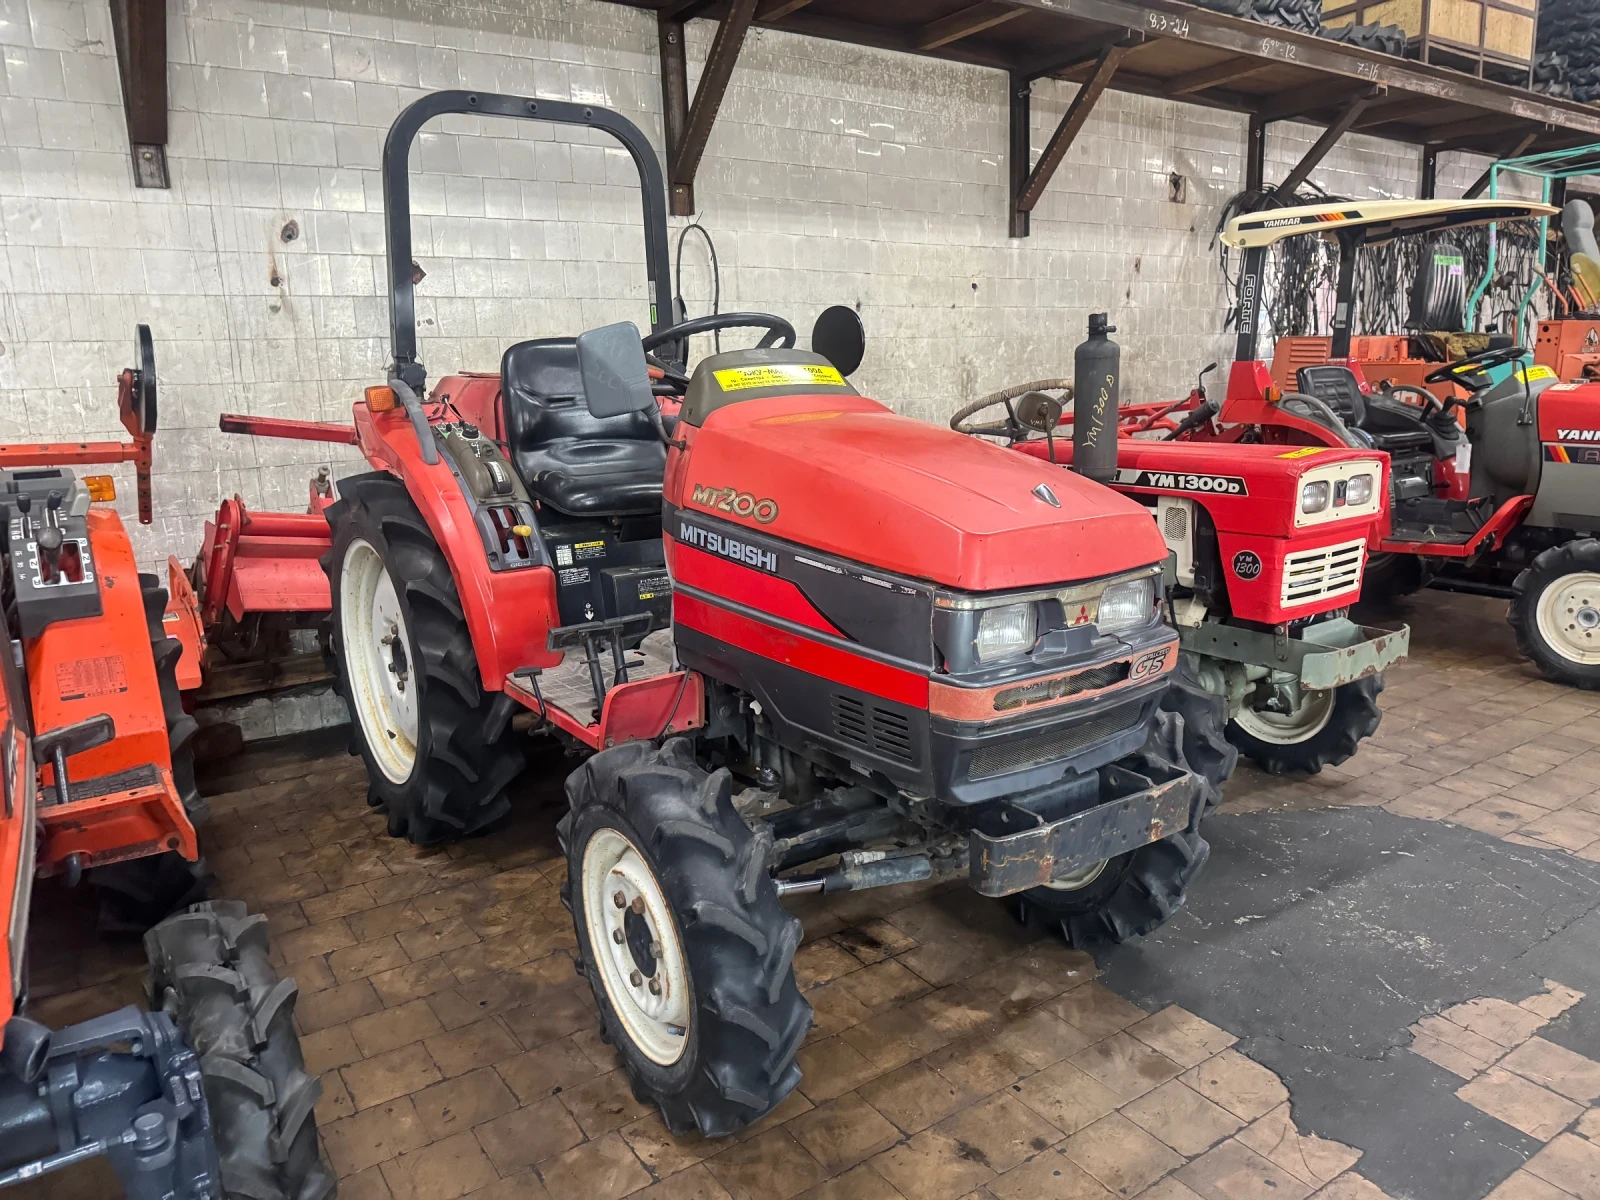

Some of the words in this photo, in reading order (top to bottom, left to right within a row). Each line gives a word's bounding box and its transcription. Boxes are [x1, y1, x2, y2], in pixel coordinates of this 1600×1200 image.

[1263, 217, 1301, 228] YANMAR
[1239, 273, 1257, 335] FORTE
[1146, 472, 1240, 494] YM1300D
[692, 484, 779, 524] MT200
[680, 522, 778, 573] MITSUBISHI
[1235, 562, 1260, 574] 1300
[1129, 654, 1167, 680] GS
